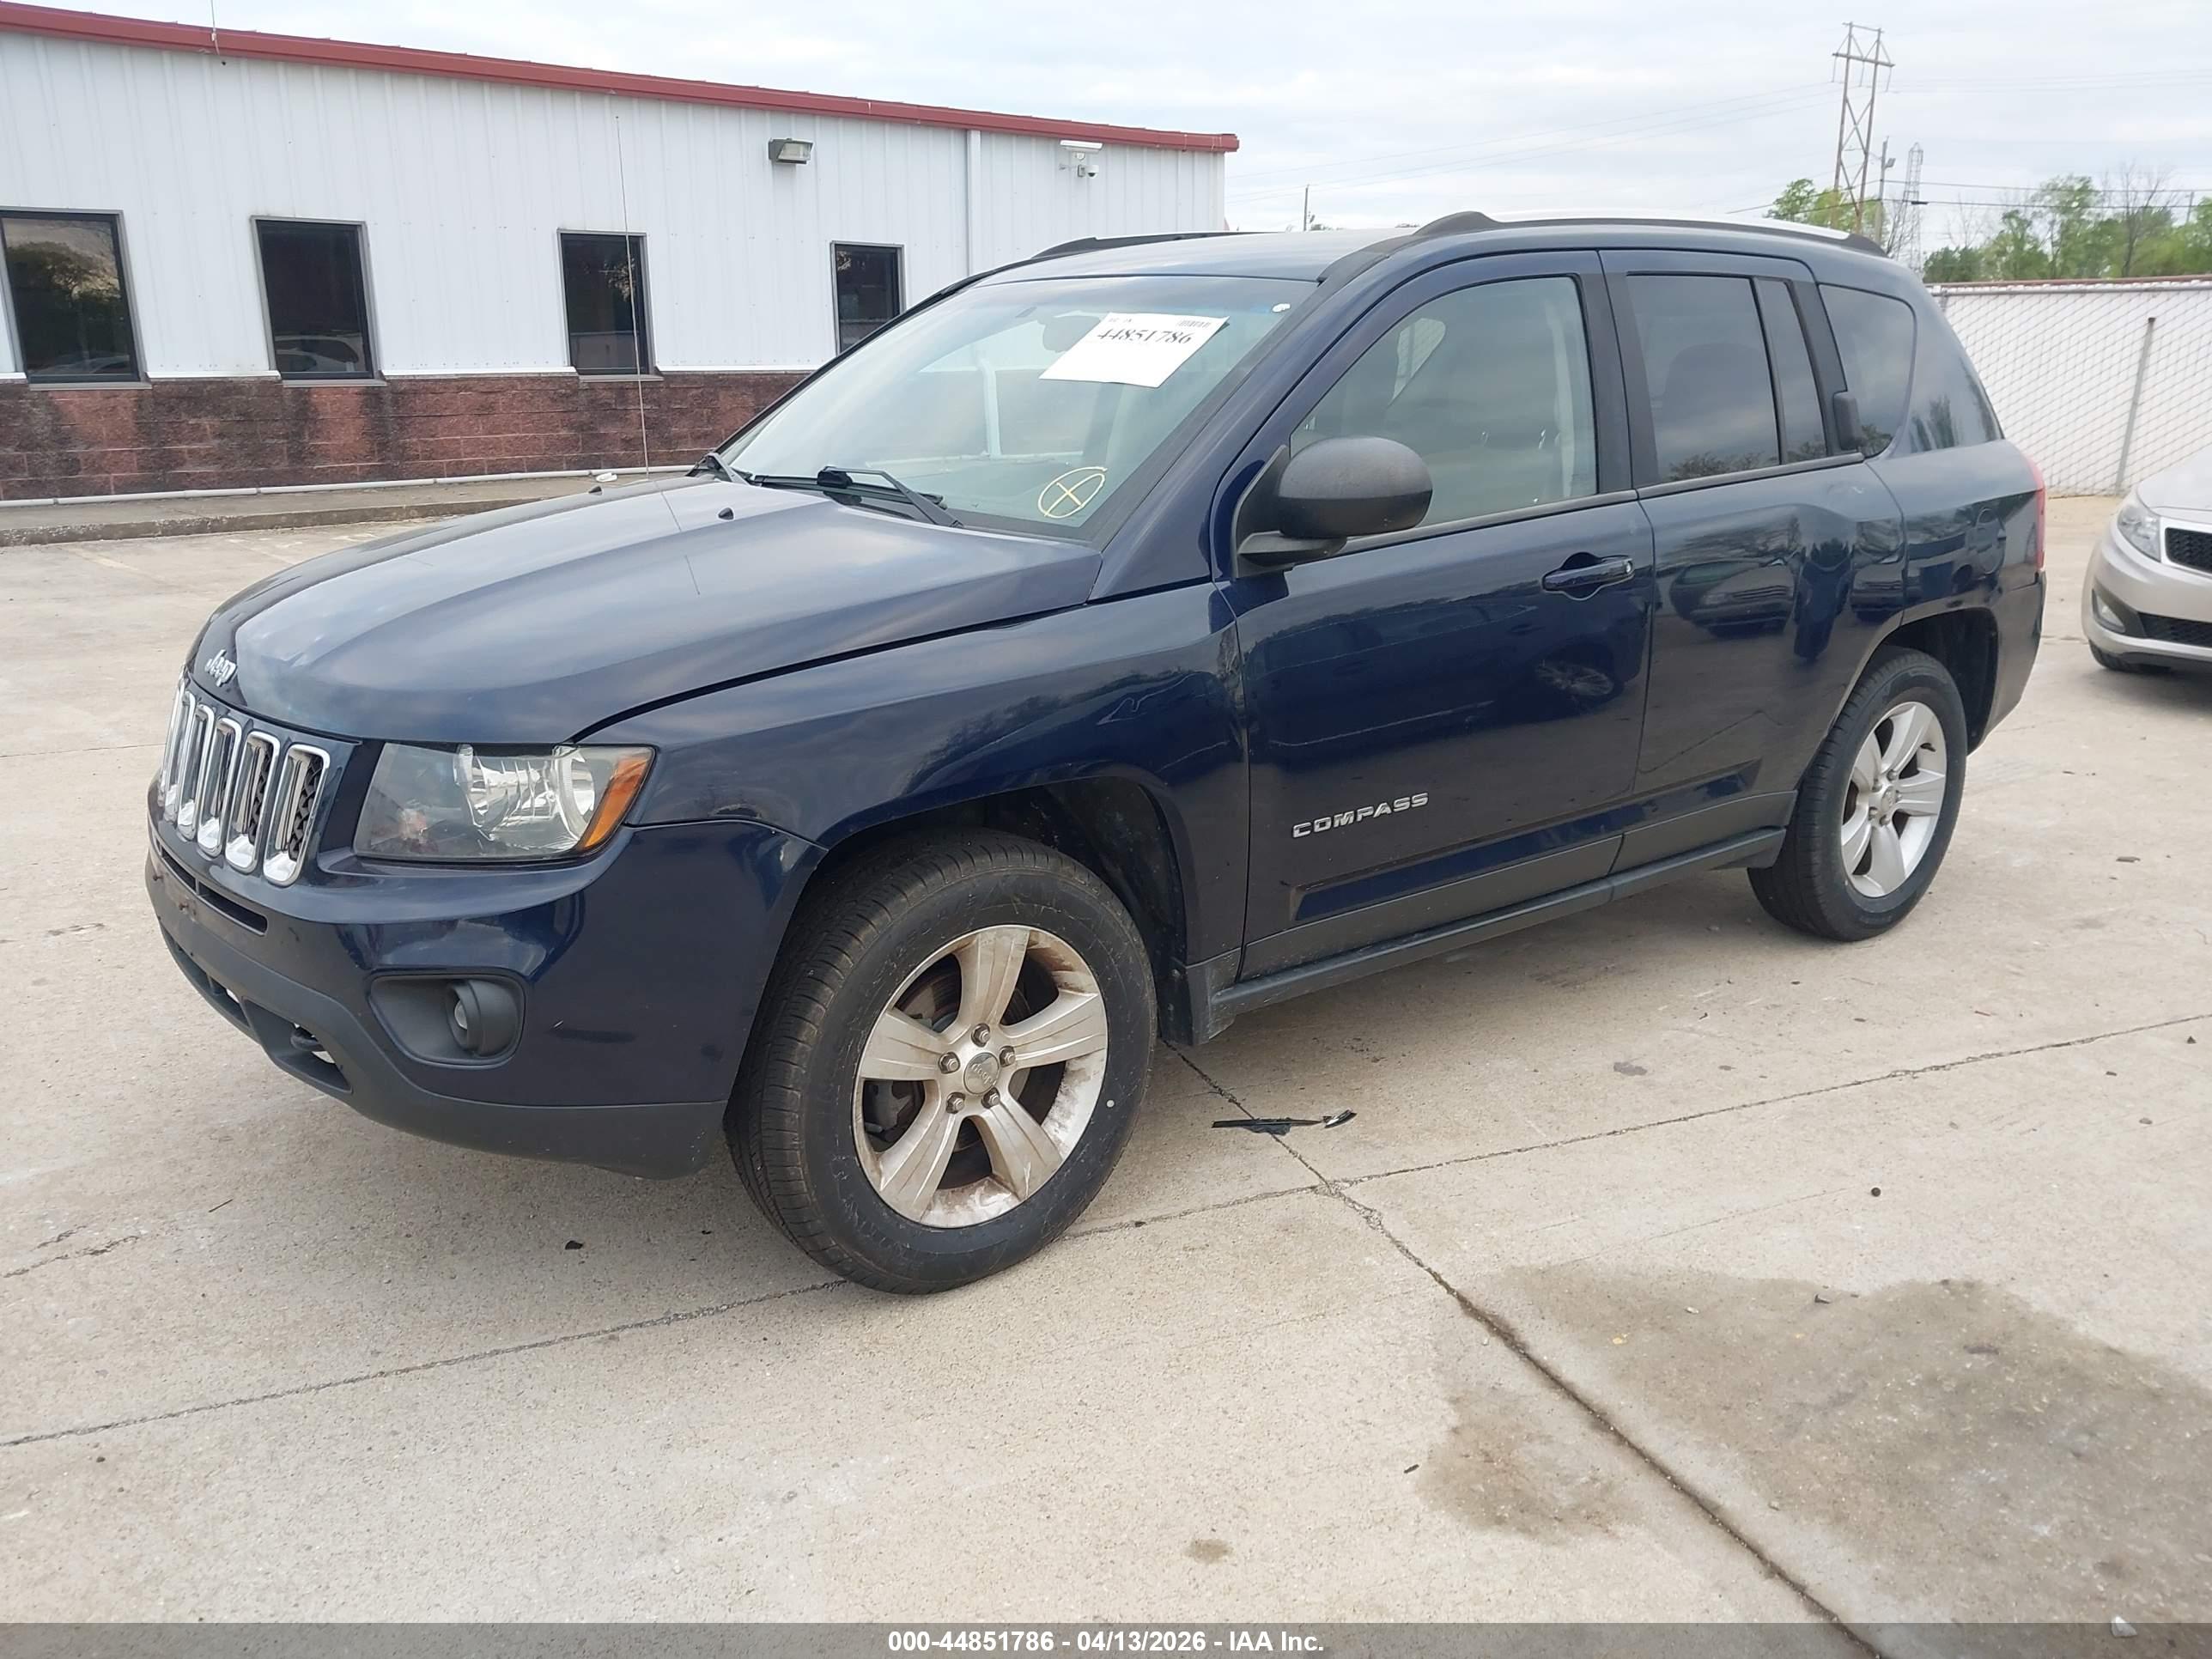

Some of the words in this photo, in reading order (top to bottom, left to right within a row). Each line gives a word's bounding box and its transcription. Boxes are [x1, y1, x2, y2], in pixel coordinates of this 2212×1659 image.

[1097, 328, 1194, 343] 44851786
[204, 649, 237, 687] Jeep
[1292, 793, 1429, 838] COMPASS
